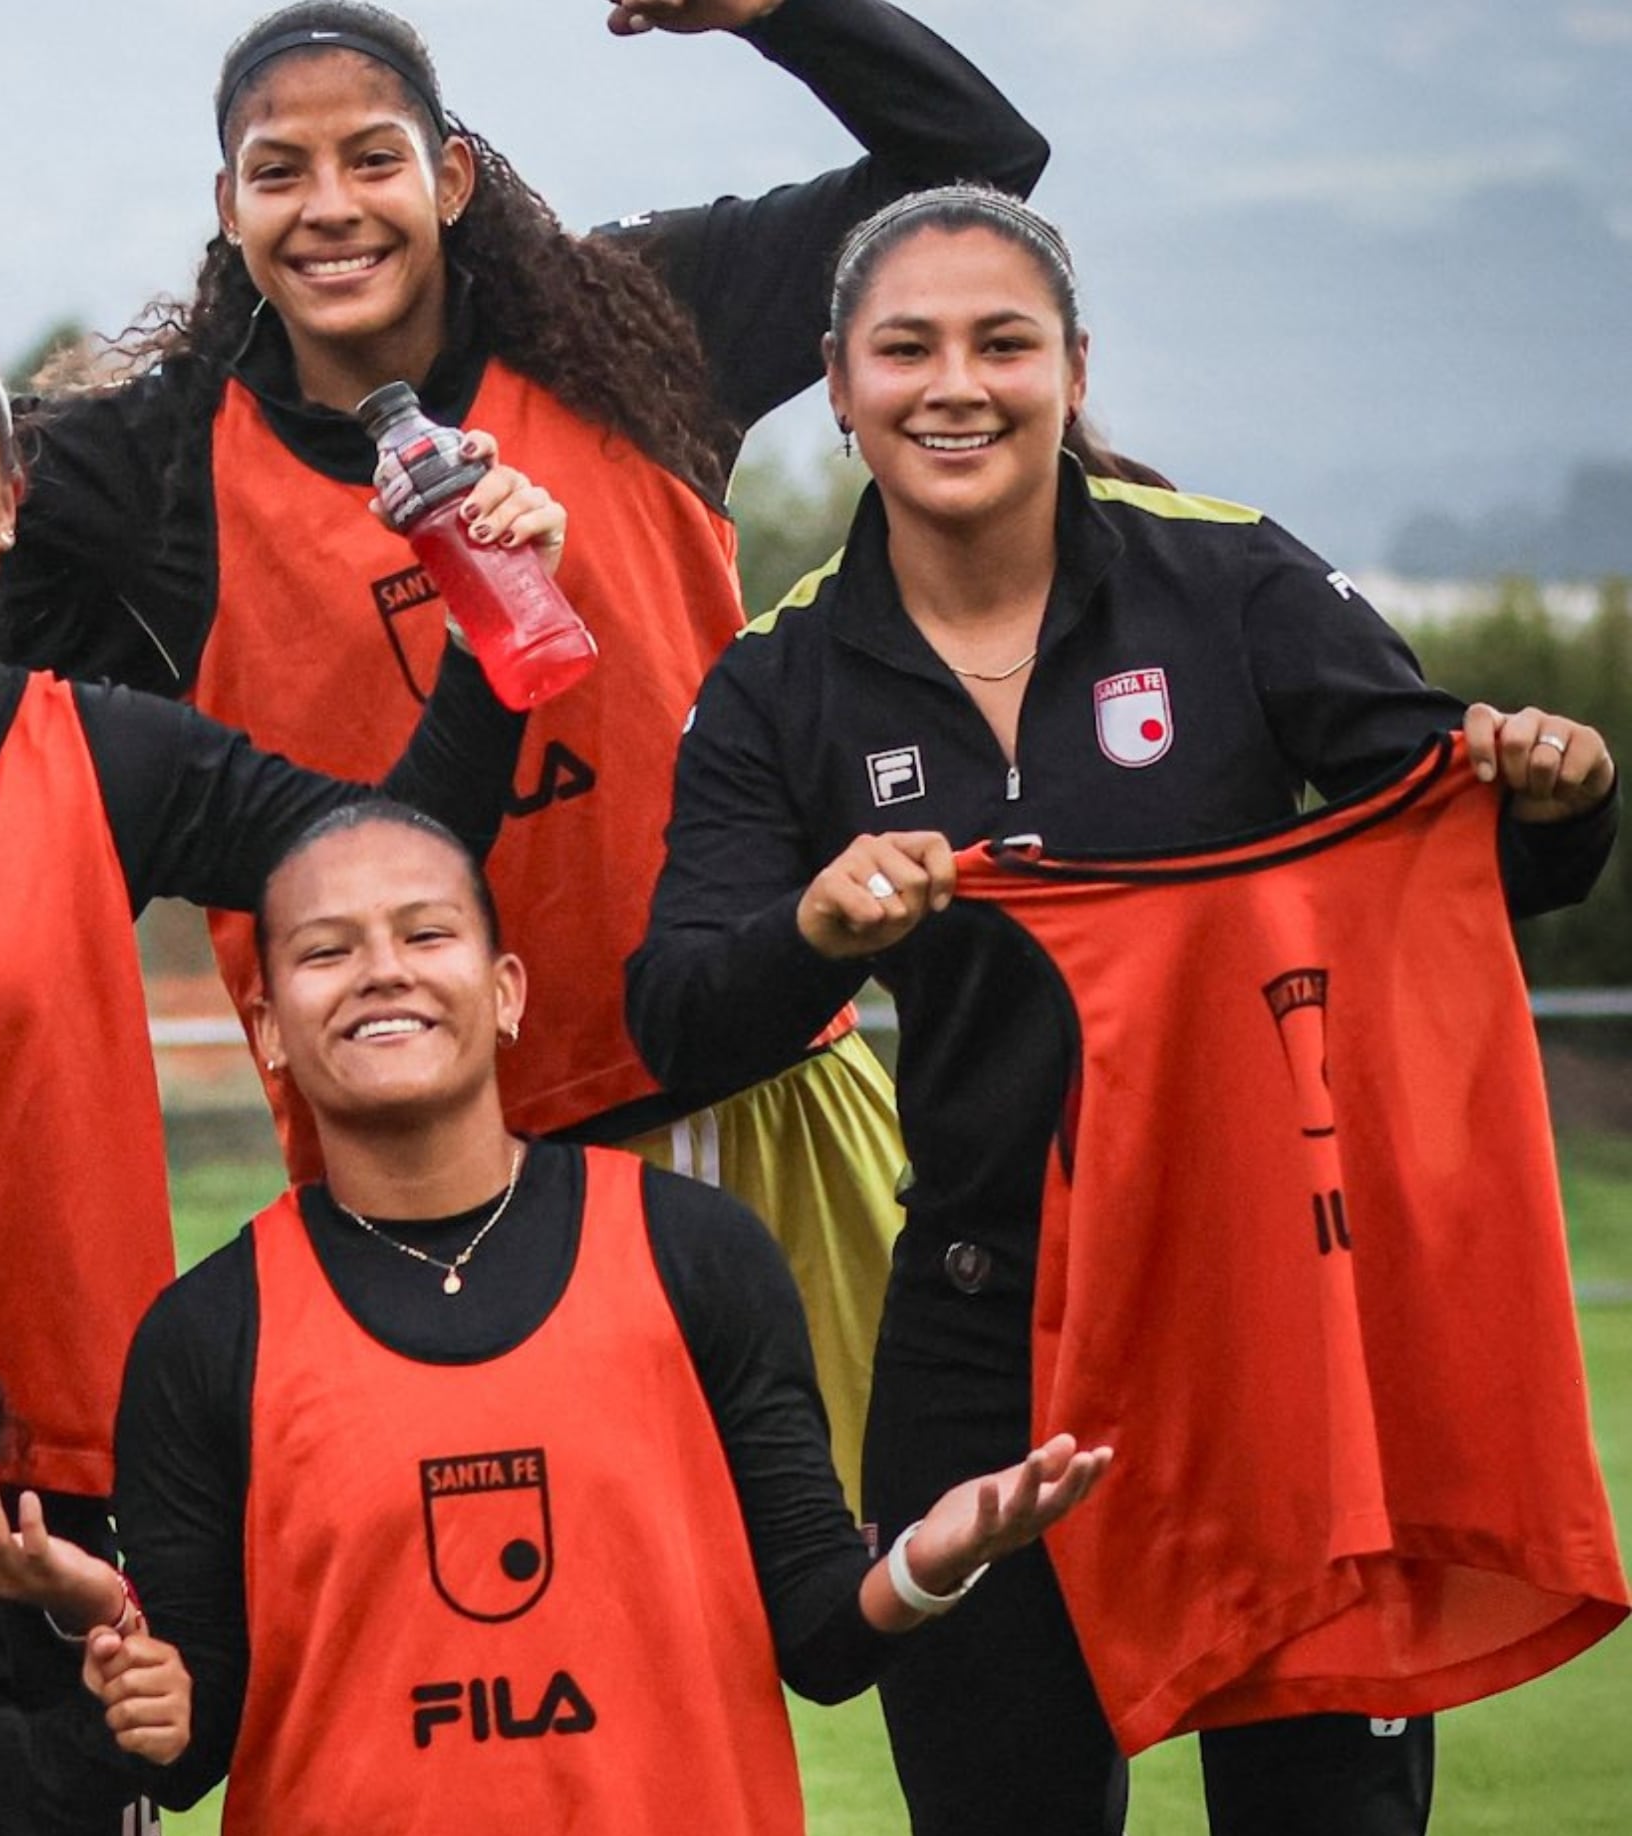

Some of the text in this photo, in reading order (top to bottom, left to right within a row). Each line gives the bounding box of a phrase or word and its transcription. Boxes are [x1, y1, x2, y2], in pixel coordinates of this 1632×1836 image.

[380, 571, 437, 609] SANT
[1096, 673, 1161, 701] SANTA FE
[427, 1457, 539, 1492] SANTA FE
[410, 1670, 597, 1749] FILA
